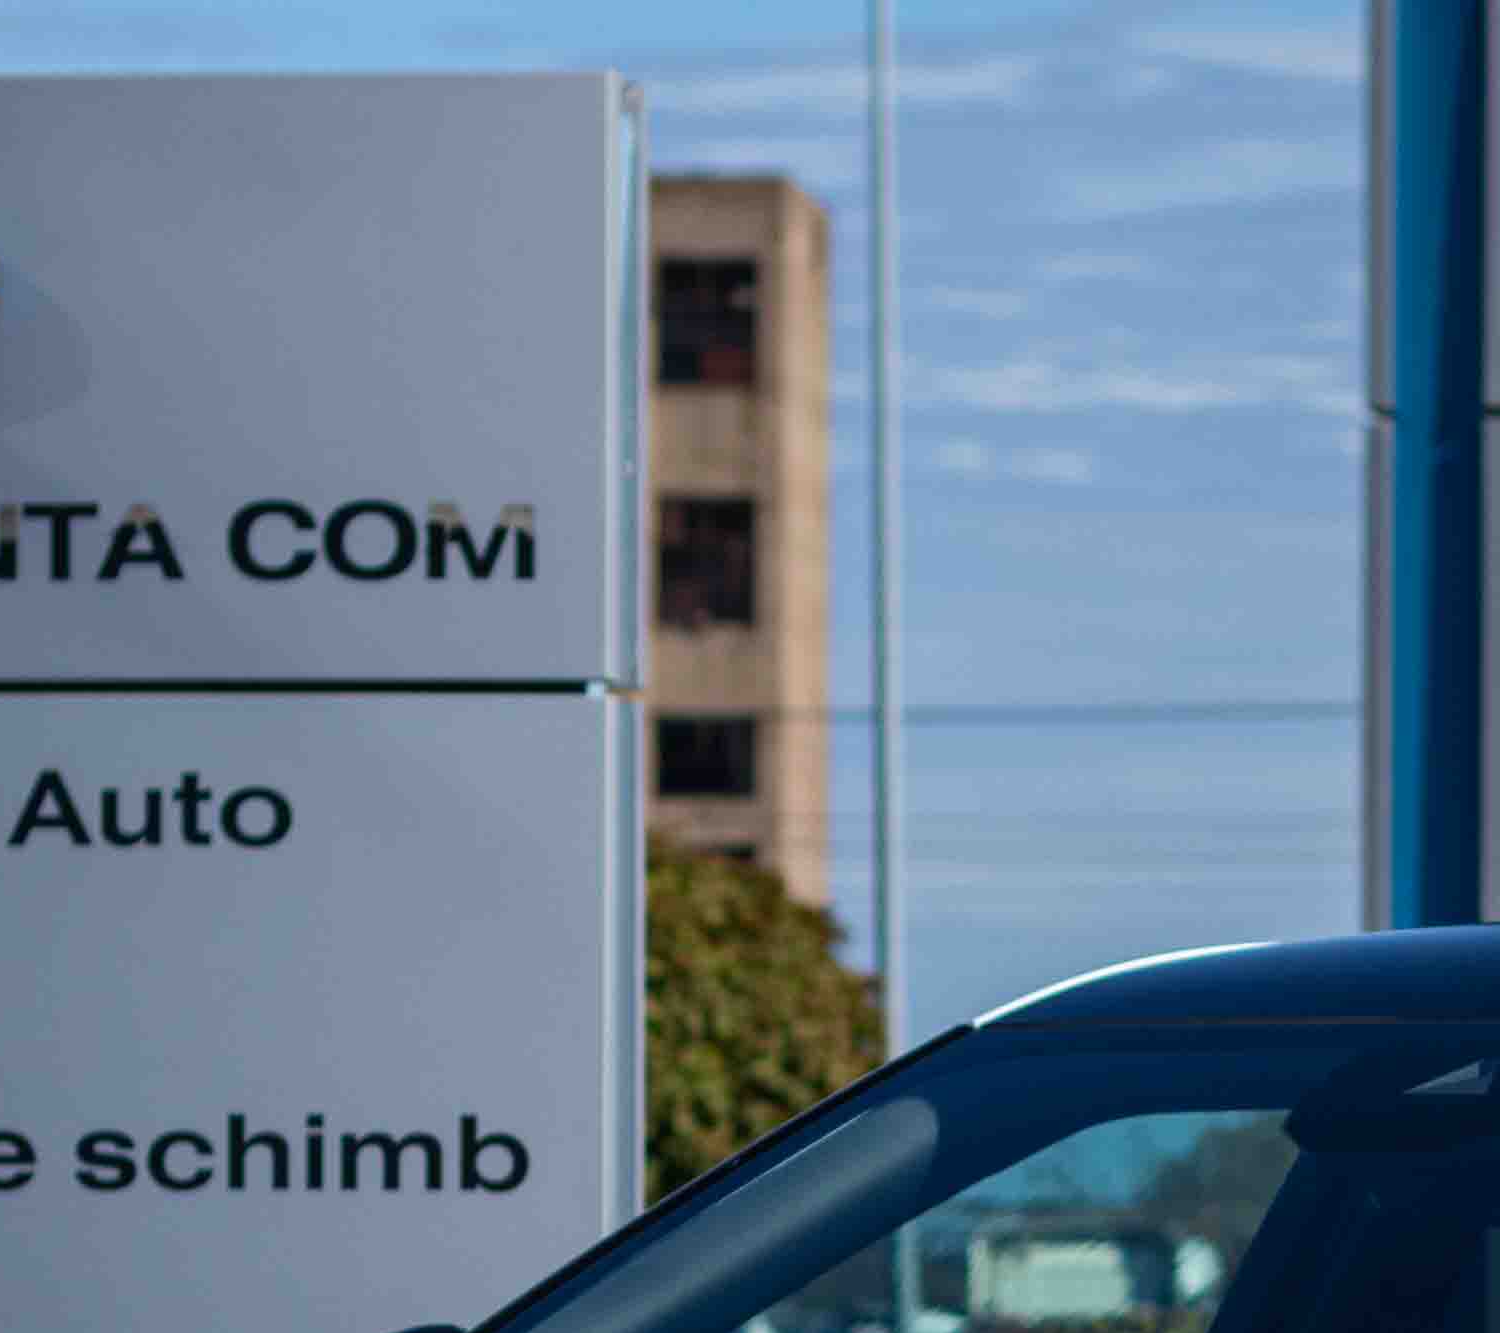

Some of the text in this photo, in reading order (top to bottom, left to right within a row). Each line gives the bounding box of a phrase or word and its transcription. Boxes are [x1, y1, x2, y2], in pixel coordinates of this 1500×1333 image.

[228, 500, 537, 582] COM
[7, 769, 294, 849] Auto
[74, 1112, 531, 1193] schimb
